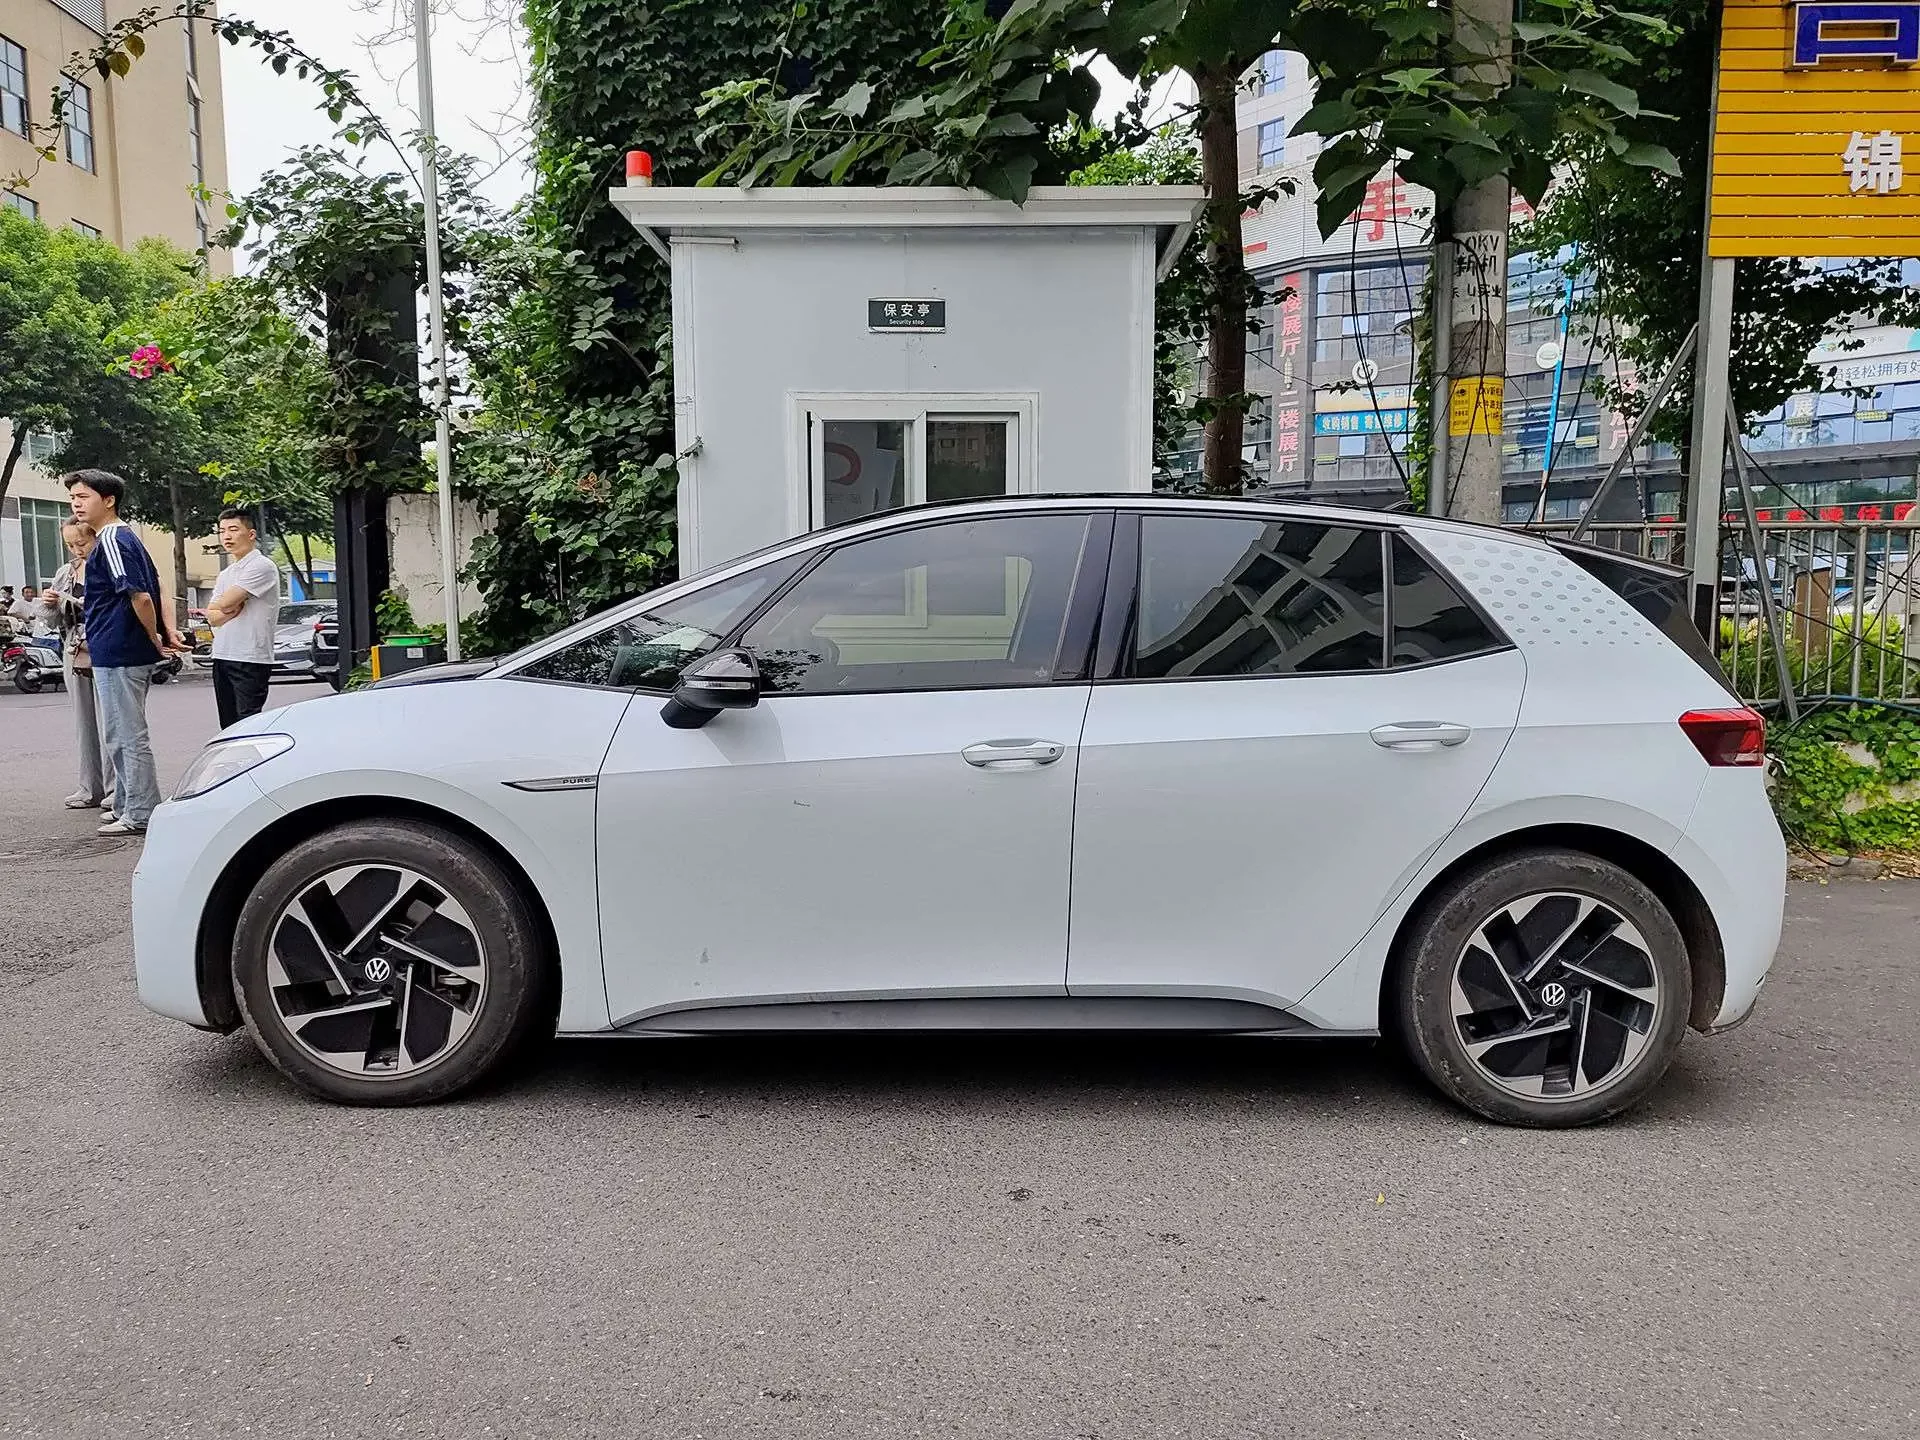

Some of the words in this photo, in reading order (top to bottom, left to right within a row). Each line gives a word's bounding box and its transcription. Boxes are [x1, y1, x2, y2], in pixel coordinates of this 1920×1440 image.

[1841, 130, 1903, 194] 锦
[884, 303, 930, 317] 保安亭
[1277, 390, 1300, 473] 二楼展厅
[562, 777, 592, 785] PURE
